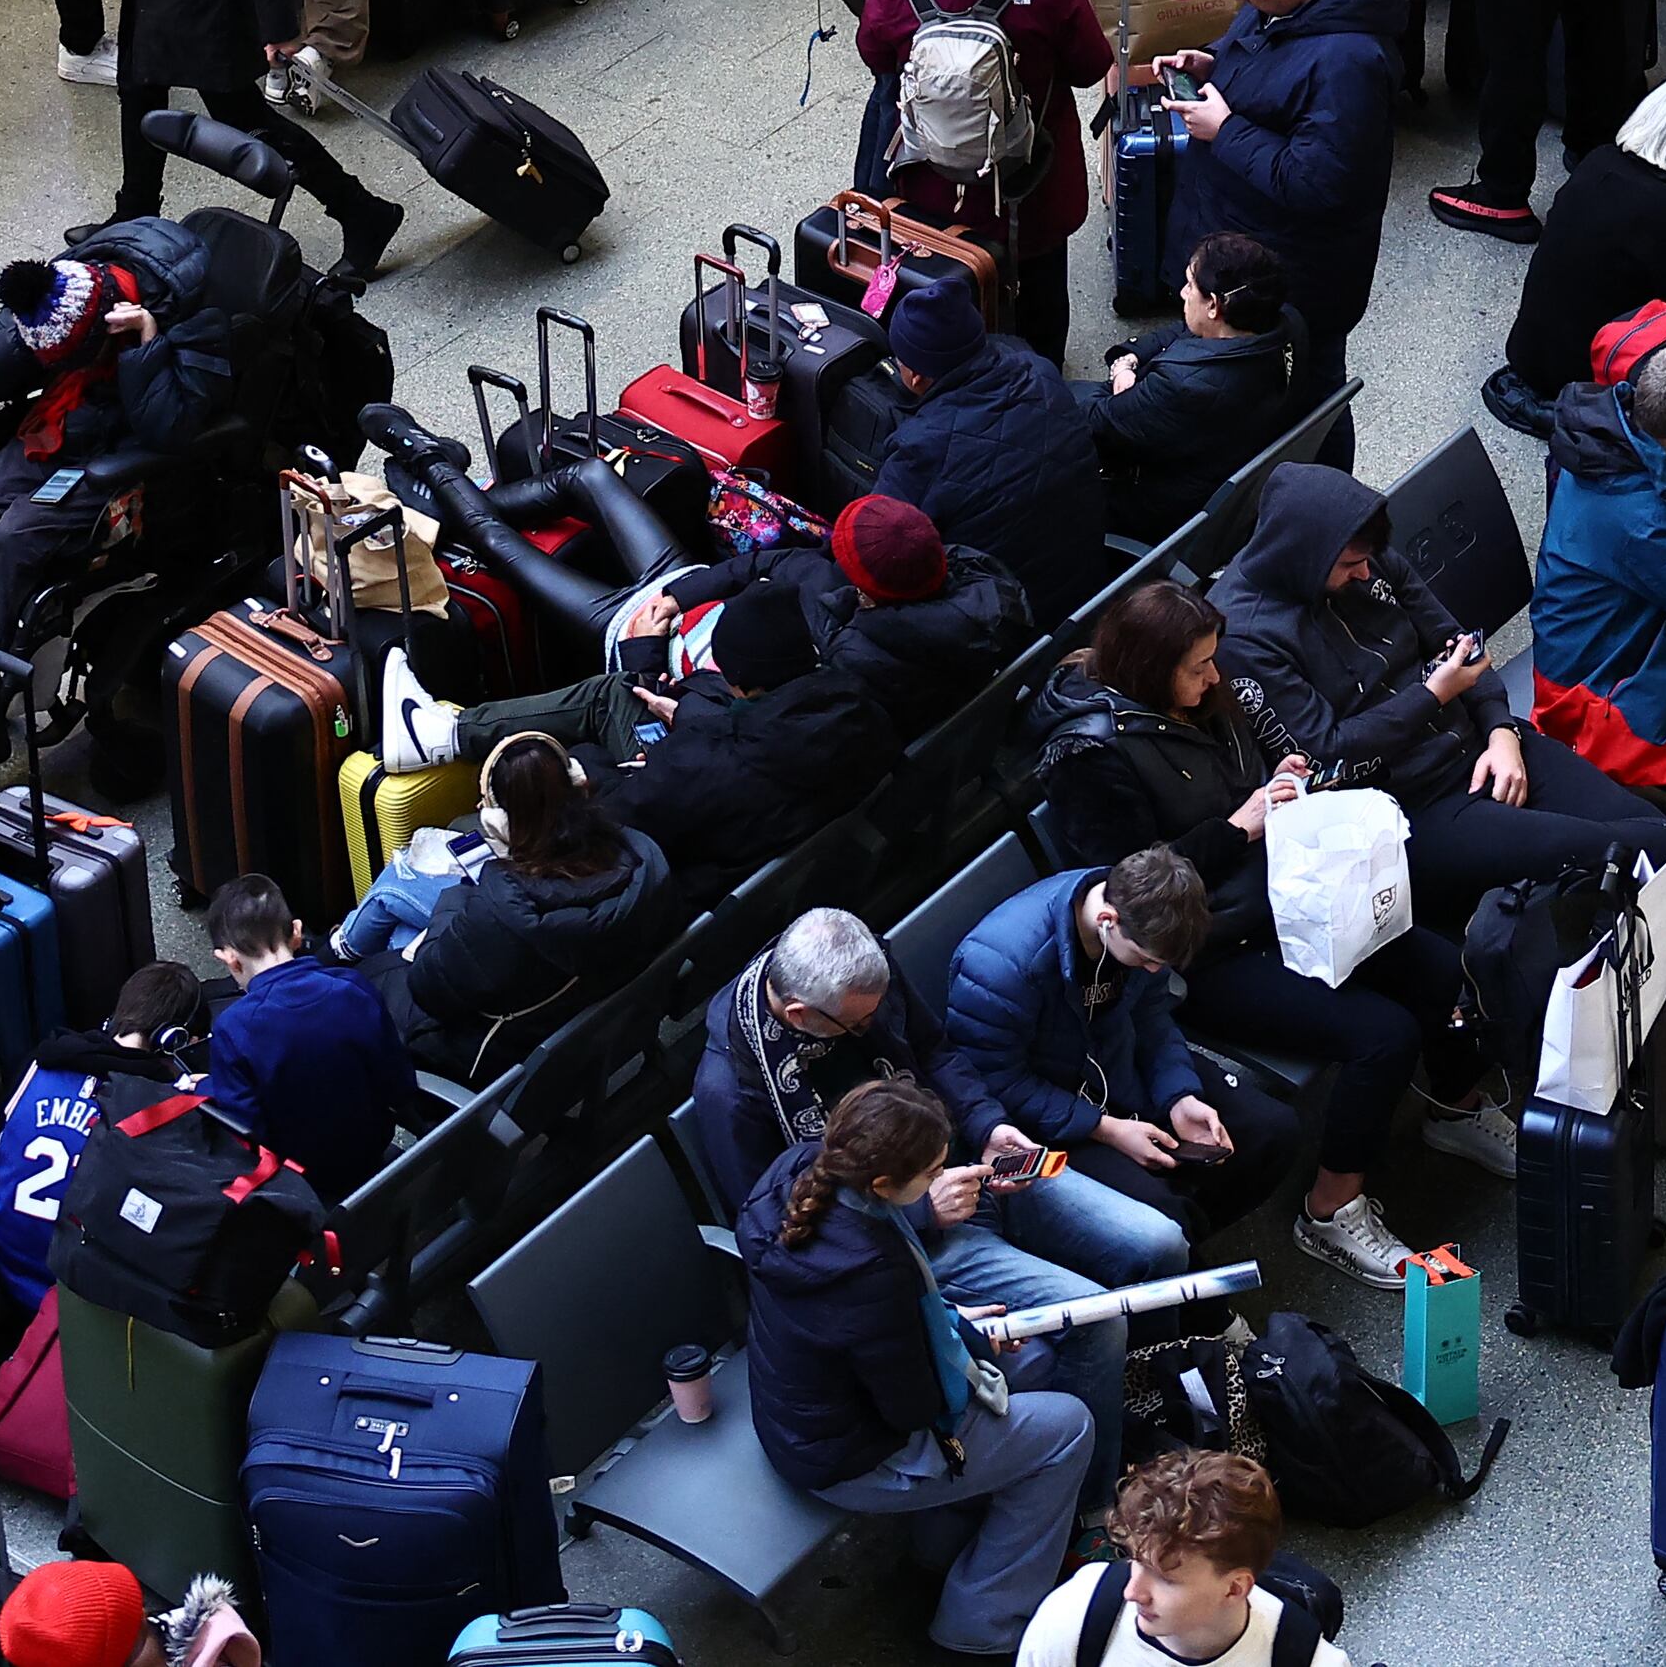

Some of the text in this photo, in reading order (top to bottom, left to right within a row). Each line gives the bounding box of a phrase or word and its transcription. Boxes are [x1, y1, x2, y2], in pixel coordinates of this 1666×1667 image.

[1156, 5, 1188, 22] GILLY
[35, 1096, 98, 1137] EMBI
[13, 1134, 81, 1222] 2
